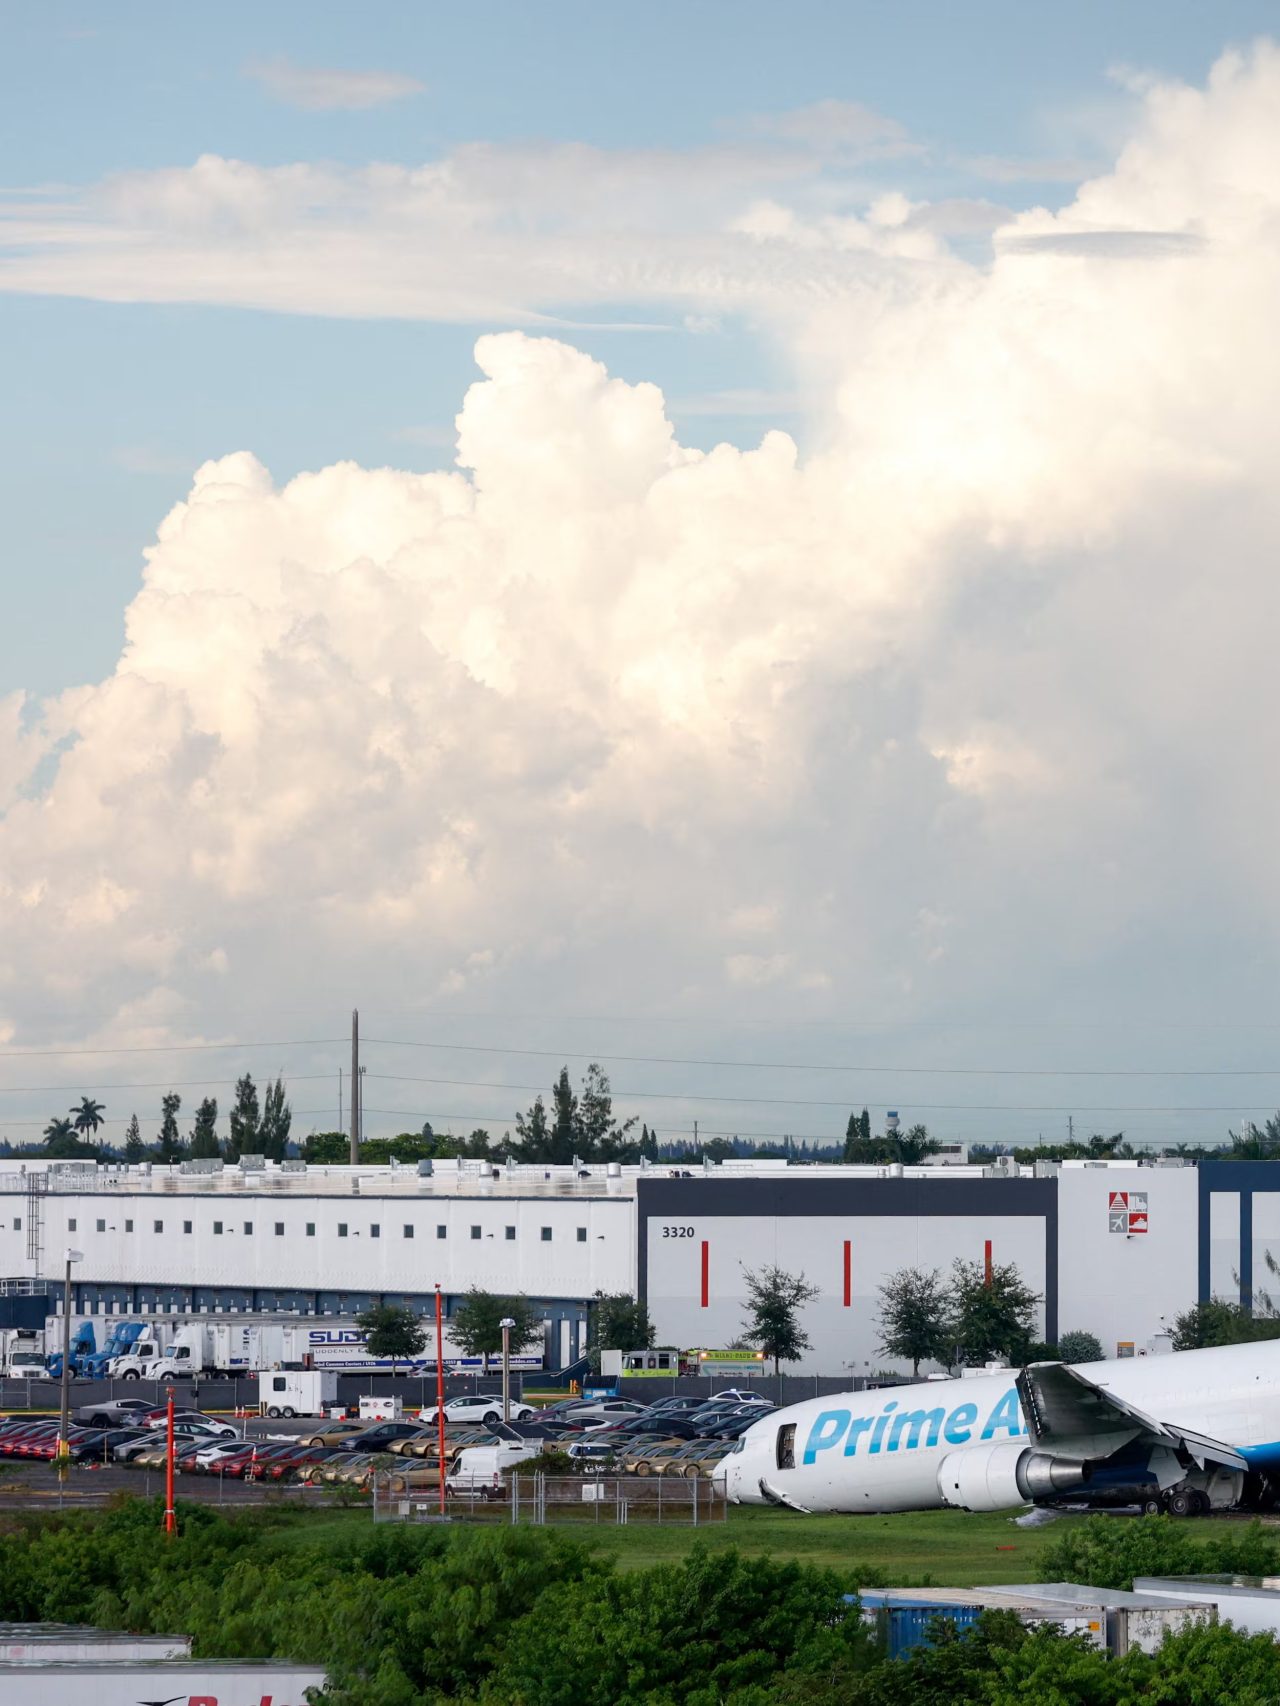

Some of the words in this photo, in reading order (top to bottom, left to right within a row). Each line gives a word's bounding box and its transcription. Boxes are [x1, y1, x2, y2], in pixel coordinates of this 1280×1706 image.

[662, 1226, 695, 1238] 3320
[803, 1401, 978, 1465] Prime
[980, 1387, 1030, 1440] A
